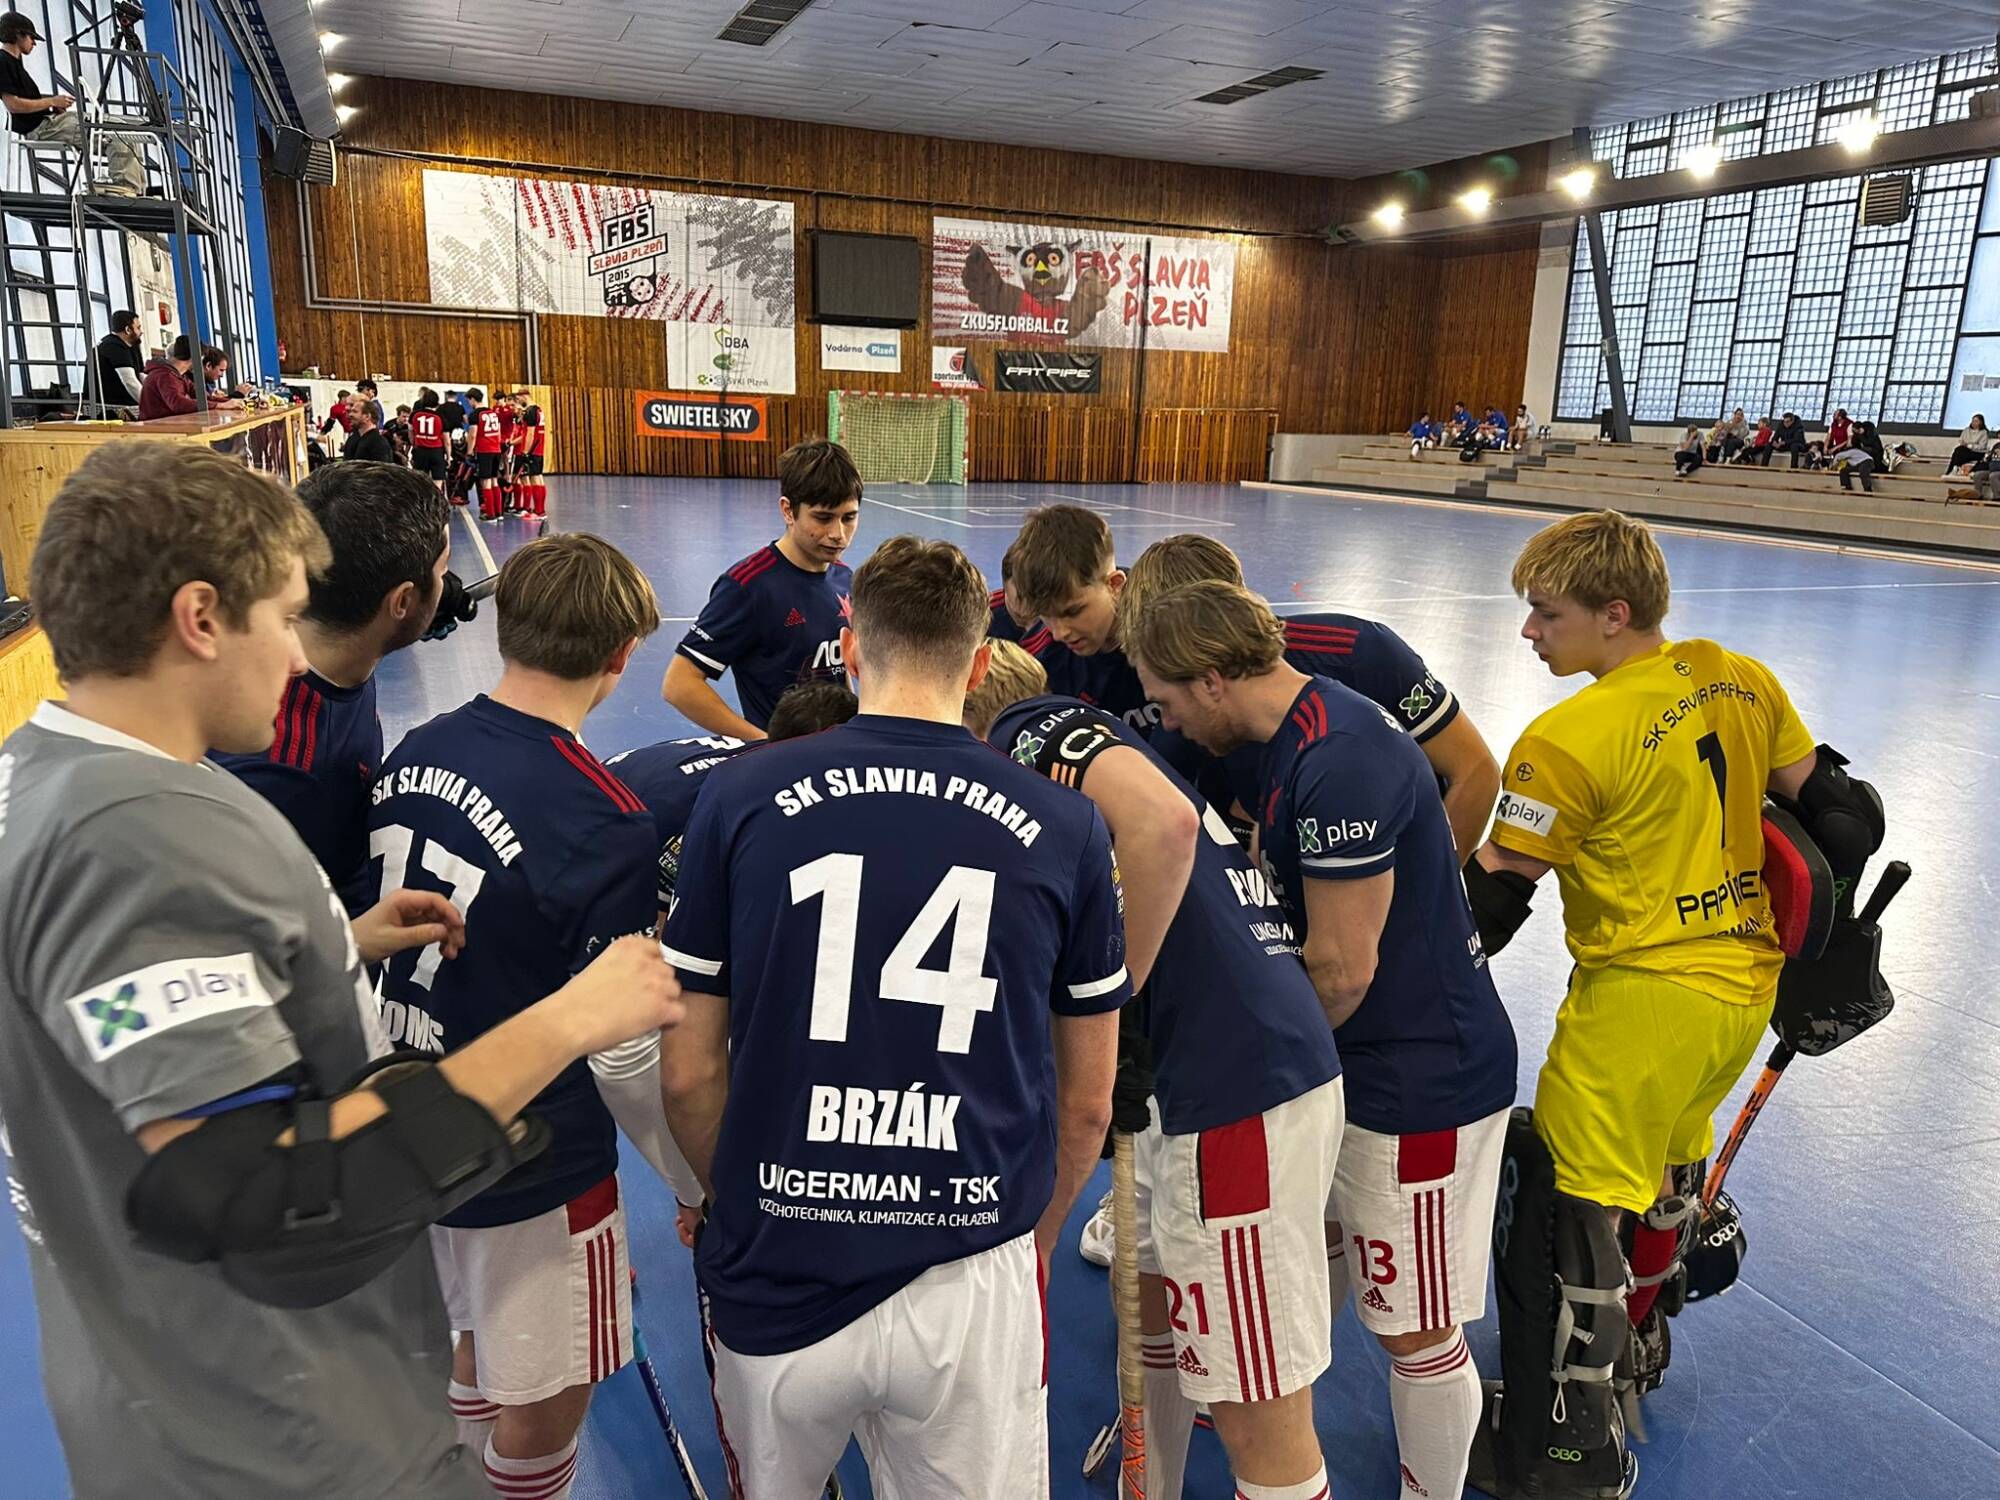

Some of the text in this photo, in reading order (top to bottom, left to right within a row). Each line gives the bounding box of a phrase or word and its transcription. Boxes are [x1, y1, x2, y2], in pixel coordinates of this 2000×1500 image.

[607, 208, 649, 247] FBŠ
[608, 268, 630, 283] 2015
[1126, 253, 1211, 291] SAVIA
[960, 313, 1069, 334] ZKUSFLORBAL.CZ
[724, 336, 749, 349] DBA
[825, 343, 895, 355] Vodárna Plzeň
[1005, 366, 1092, 378] FAT PIPE
[417, 415, 435, 435] 11
[481, 412, 500, 433] 25
[651, 403, 751, 429] SWIETELSKY
[811, 639, 844, 669] AO
[1425, 671, 1438, 694] pl
[1642, 722, 1668, 752] SK
[1662, 687, 1709, 729] SLAVIA
[1695, 730, 1727, 850] 1
[371, 765, 524, 867] SK SLAVIA PRAHA
[774, 767, 1043, 849] SK SLAVIA PRAHA
[1508, 802, 1545, 828] play
[1326, 818, 1378, 848] play
[369, 823, 487, 992] 17
[789, 852, 999, 1055] 14
[161, 968, 250, 1013] play
[806, 1081, 962, 1152] BRZÁK
[949, 1175, 1001, 1205] TSK
[858, 1210, 935, 1226] KLIMATIZACE
[937, 1215, 947, 1227] A
[949, 1207, 1000, 1227] CHLAZENÍ
[1709, 1222, 1738, 1247] OBO
[1353, 1235, 1397, 1285] 13
[1162, 1276, 1210, 1335] 21
[1361, 1296, 1393, 1313] adidas
[1177, 1359, 1209, 1377] adidas
[1548, 1446, 1582, 1462] OBO
